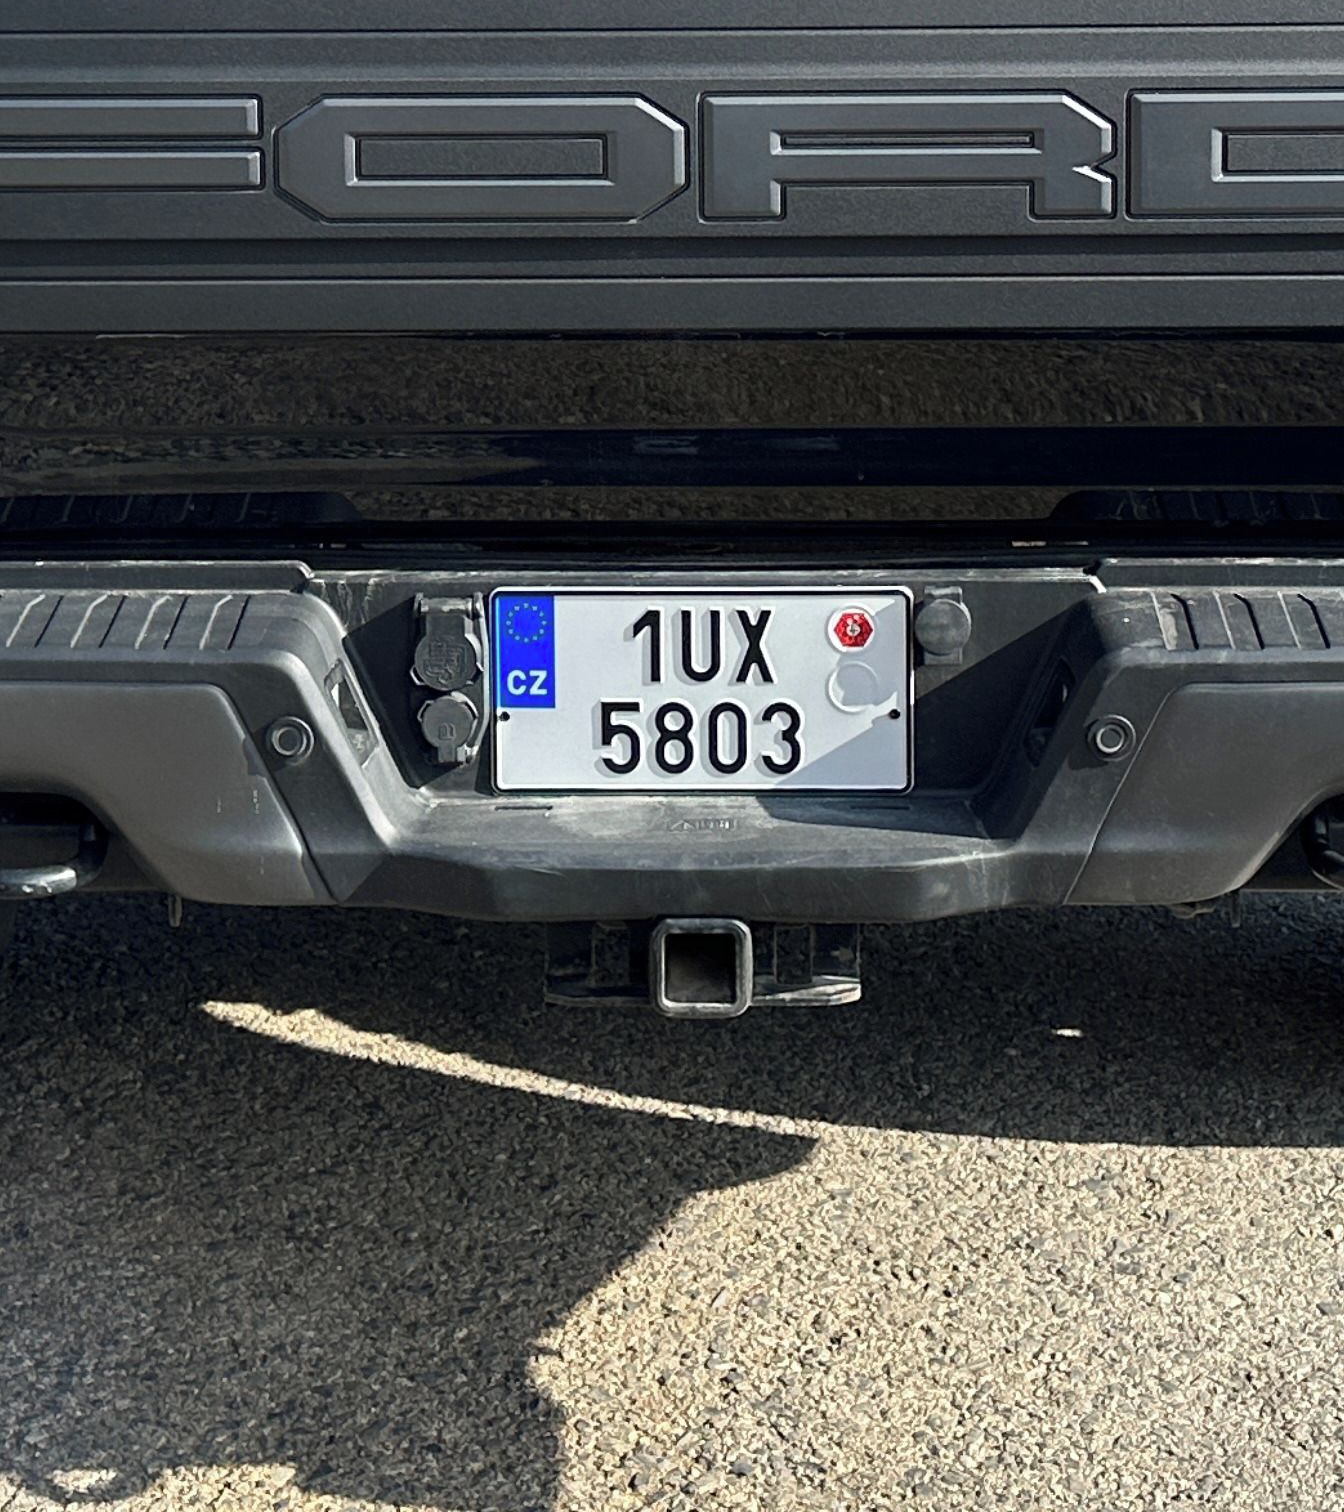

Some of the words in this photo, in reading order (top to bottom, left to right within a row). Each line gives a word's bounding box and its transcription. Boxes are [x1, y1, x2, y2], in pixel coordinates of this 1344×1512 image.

[506, 670, 548, 696] CZ
[631, 609, 775, 684] 1UX
[599, 701, 801, 775] 5803
